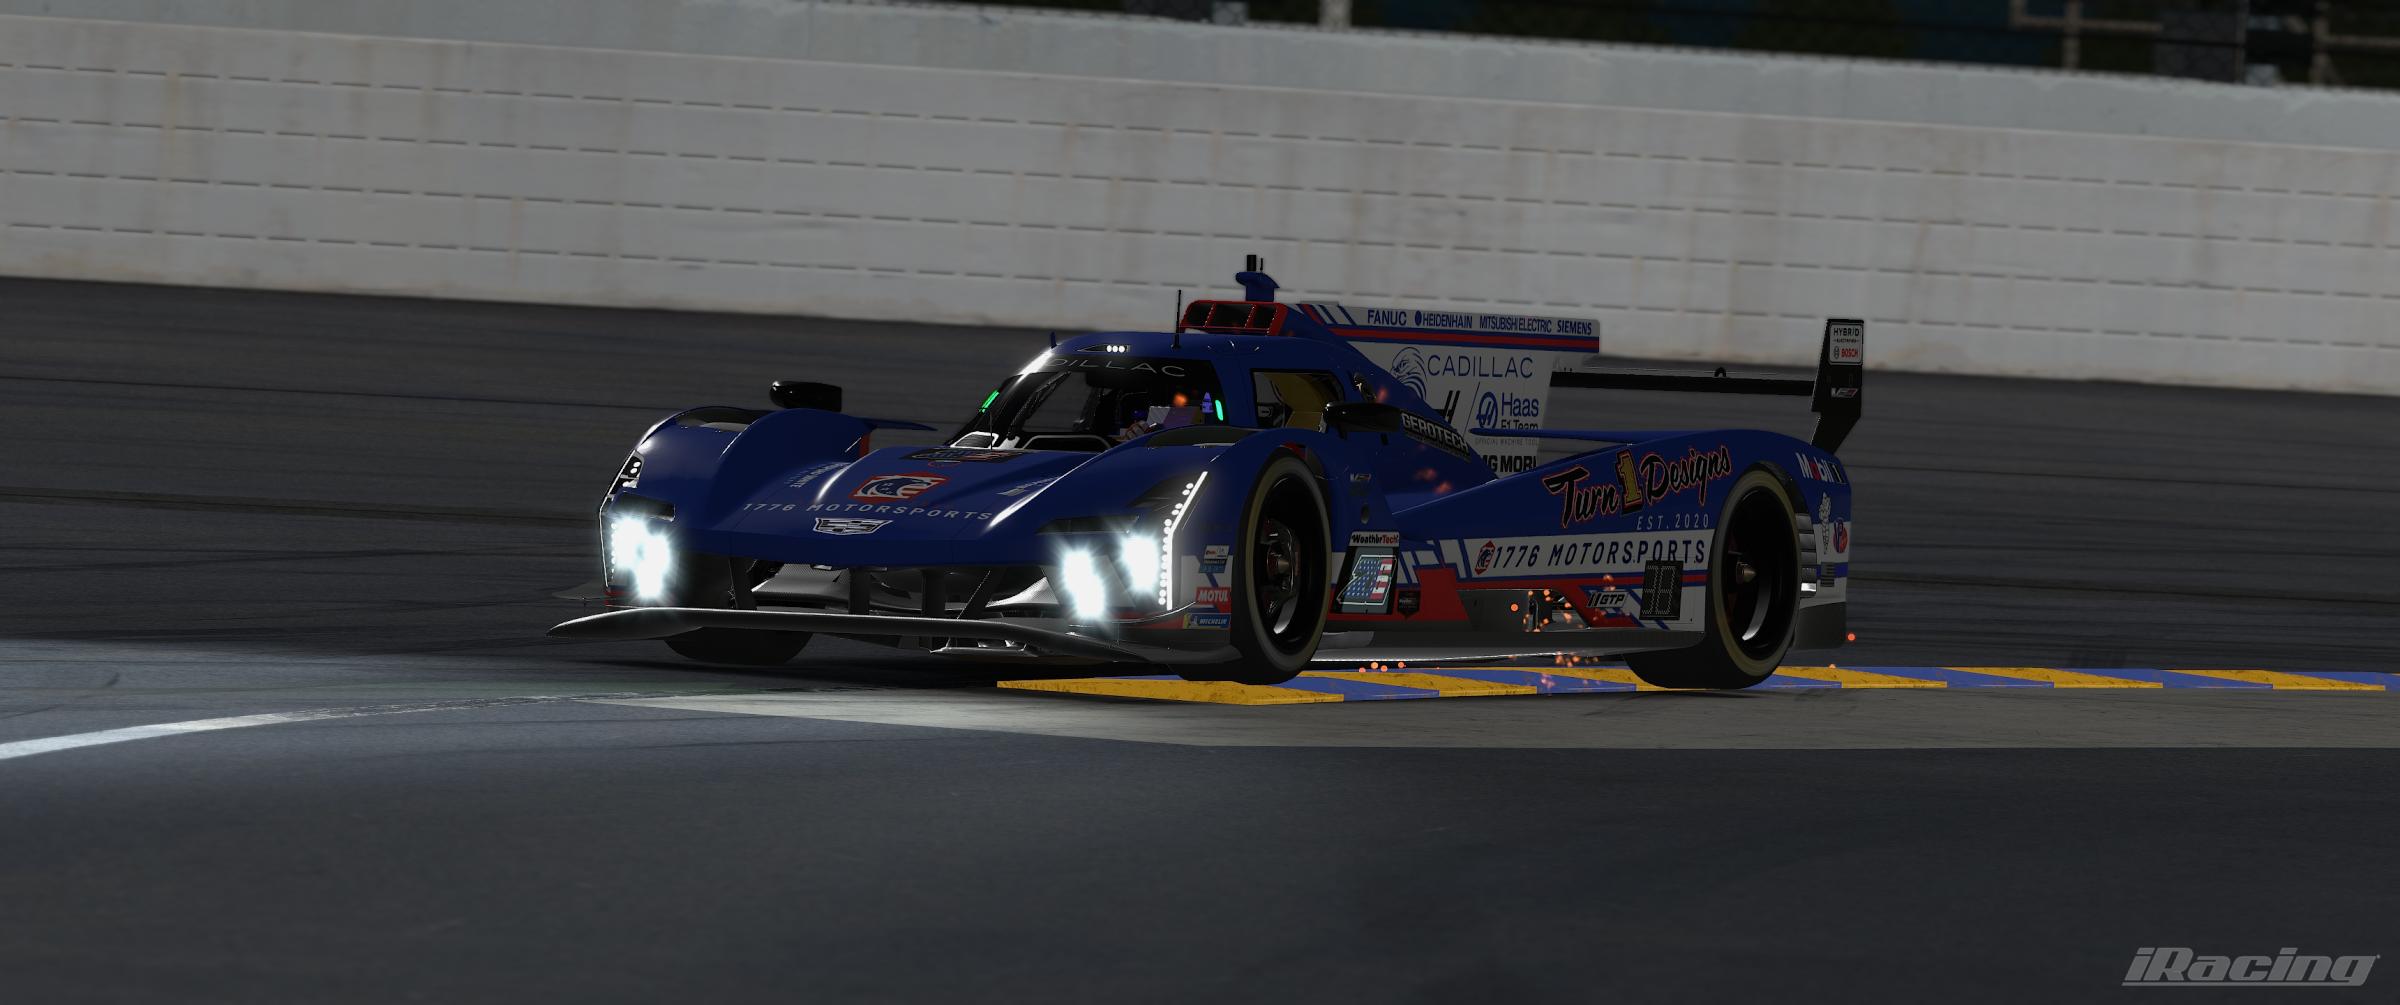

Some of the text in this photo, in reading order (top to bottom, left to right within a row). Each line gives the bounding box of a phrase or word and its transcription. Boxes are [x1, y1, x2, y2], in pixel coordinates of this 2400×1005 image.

[1367, 309, 1407, 326] FANUC
[1422, 312, 1473, 329] HEIDENHAIN
[1479, 315, 1552, 333] MITSUBISHI ELECTRIC
[1557, 319, 1592, 335] SIEMENS
[1833, 327, 1860, 337] HYBRID
[1841, 348, 1859, 358] BOSCH
[1046, 358, 1186, 378] DILLAC
[1427, 354, 1534, 379] CADILLAC
[1501, 392, 1539, 417] Haas
[1401, 412, 1470, 457] GEROTECH
[1543, 445, 1731, 528] Turn 1 Designs
[743, 503, 993, 521] 1776 MOTORSPORTS
[1674, 513, 1710, 530] 2020
[1493, 540, 1705, 569] 1776 MOTORSPORTS
[1198, 589, 1229, 602] MOTUL
[1600, 593, 1625, 605] GTP
[1200, 616, 1228, 625] MICHELIN
